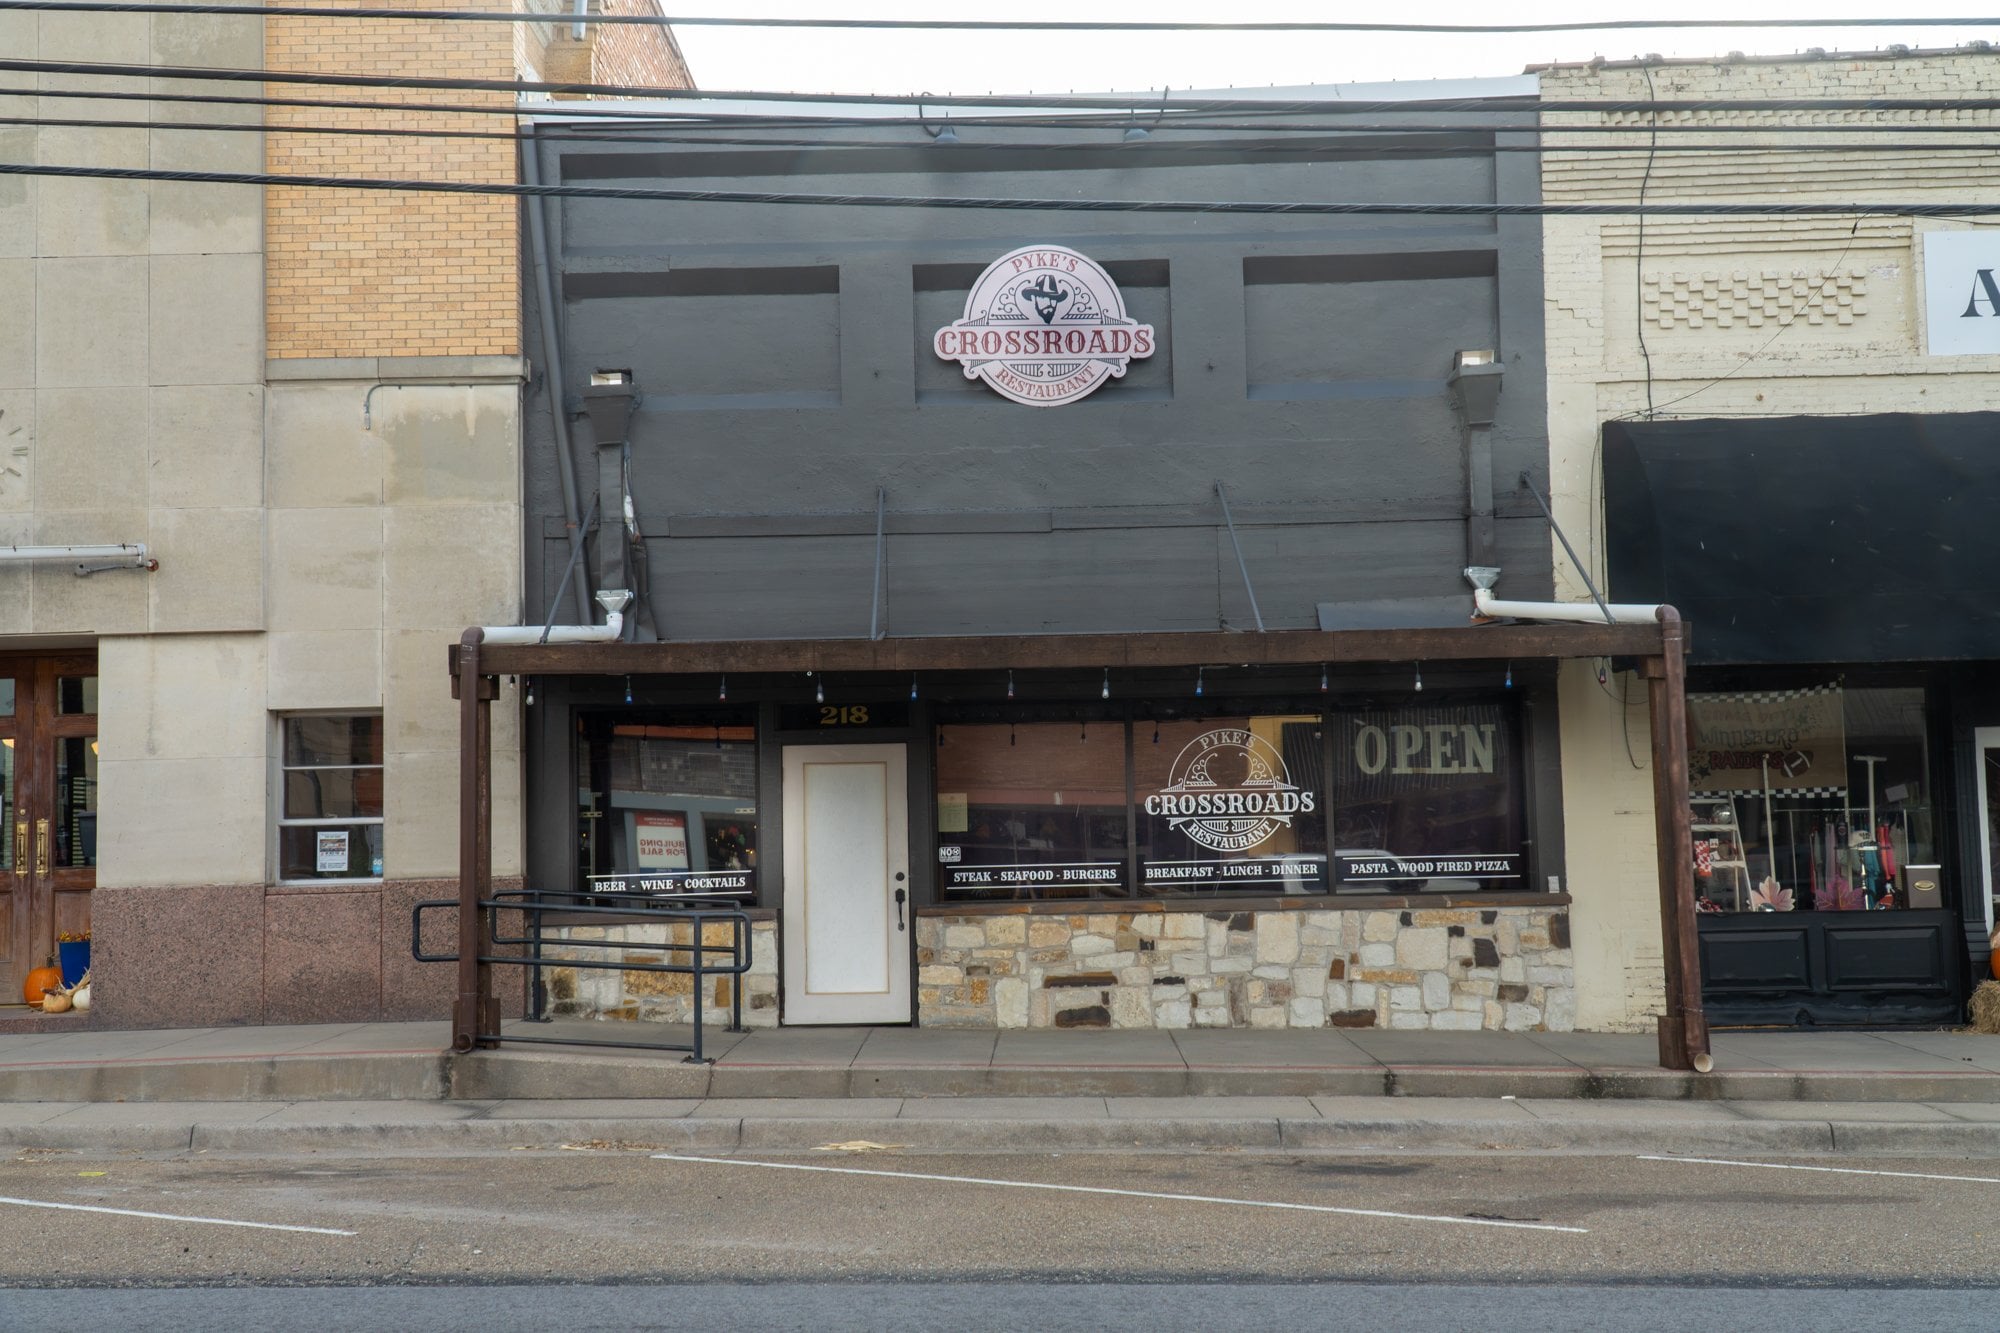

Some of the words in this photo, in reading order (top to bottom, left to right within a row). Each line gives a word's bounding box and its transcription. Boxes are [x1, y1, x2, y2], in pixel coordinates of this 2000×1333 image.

[1010, 252, 1079, 273] PYKE'S
[937, 328, 1151, 355] CROSSROADS
[994, 365, 1096, 398] RESTAURANT
[820, 706, 869, 725] 218
[1199, 731, 1257, 749] PYKE'S
[1355, 723, 1496, 775] OPEN
[1144, 791, 1315, 815] CROSSROADS
[1187, 820, 1272, 849] RESTAURANT
[940, 847, 952, 857] NO
[954, 871, 992, 882] STEAK
[1000, 870, 1054, 881] SEAFOOD
[1063, 869, 1117, 880] BURGERS
[1146, 867, 1214, 878] BREAKFAST
[1223, 865, 1263, 876] LUNCH
[1272, 864, 1318, 875] DINNER
[1351, 863, 1389, 874] PASTA
[1397, 862, 1434, 873] WOOD
[1436, 861, 1472, 872] FIRED
[1474, 860, 1510, 871] PIZZA
[594, 881, 626, 892] BEER
[640, 879, 674, 891] WINE
[684, 876, 746, 889] COCKTAILS
